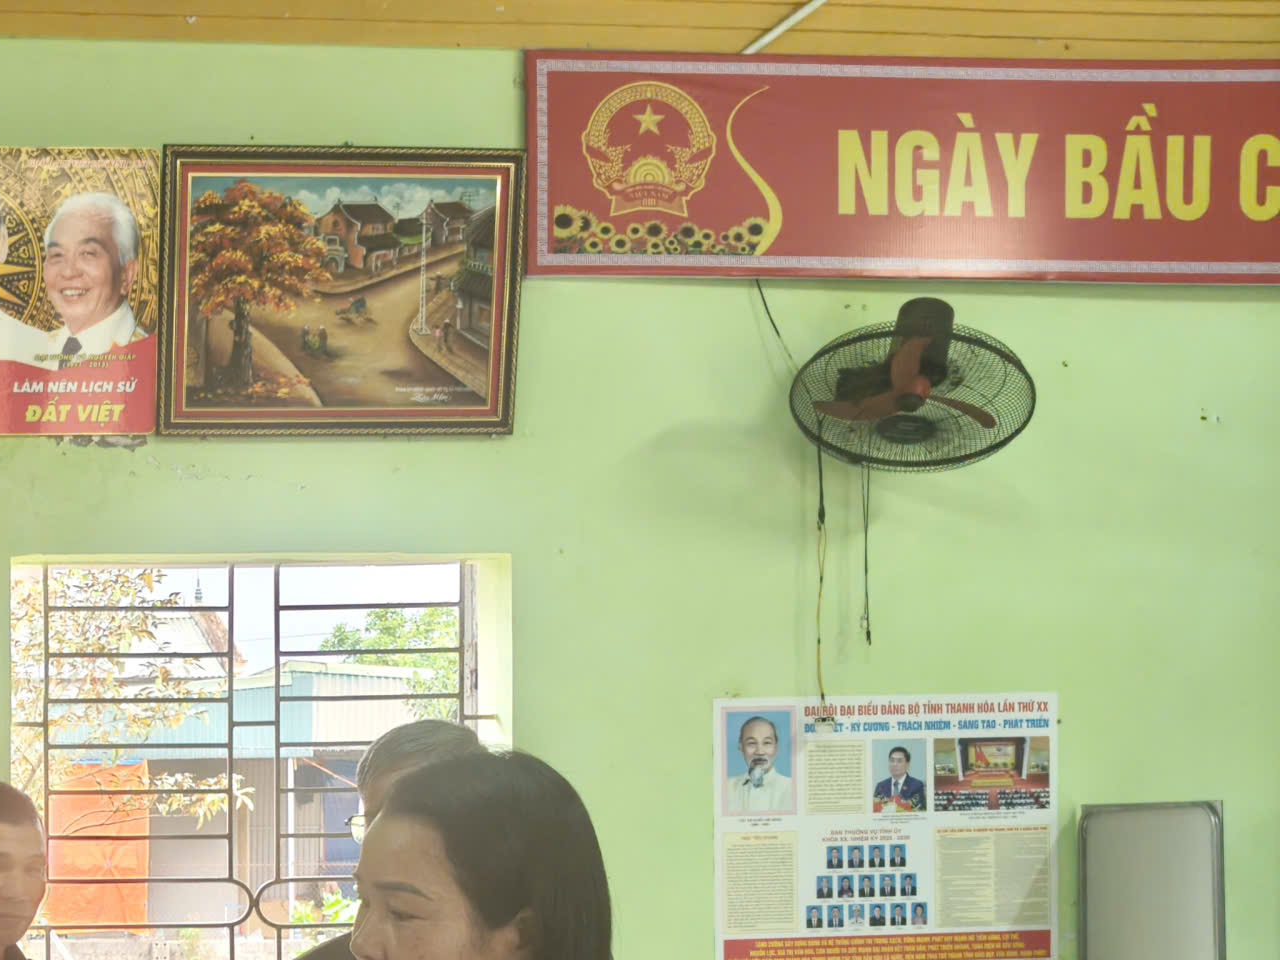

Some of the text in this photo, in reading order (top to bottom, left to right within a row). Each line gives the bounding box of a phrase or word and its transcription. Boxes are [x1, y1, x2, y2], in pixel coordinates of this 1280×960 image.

[837, 112, 1039, 218] NGÀY
[1065, 103, 1212, 221] BẦU
[13, 377, 138, 396] LÀM NÊN LỊCH SỬ
[25, 396, 126, 427] ĐẤT VIỆT
[840, 704, 856, 717] ĐẠI
[858, 701, 879, 716] BIỂU
[881, 702, 906, 715] ĐẢNG
[908, 702, 920, 717] BỘ
[923, 701, 943, 715] TỈNH
[945, 702, 975, 714] THANH
[977, 701, 995, 714] HÒA
[997, 698, 1015, 713] LẦN
[1018, 700, 1035, 713] THỨ
[1036, 701, 1049, 712] XX
